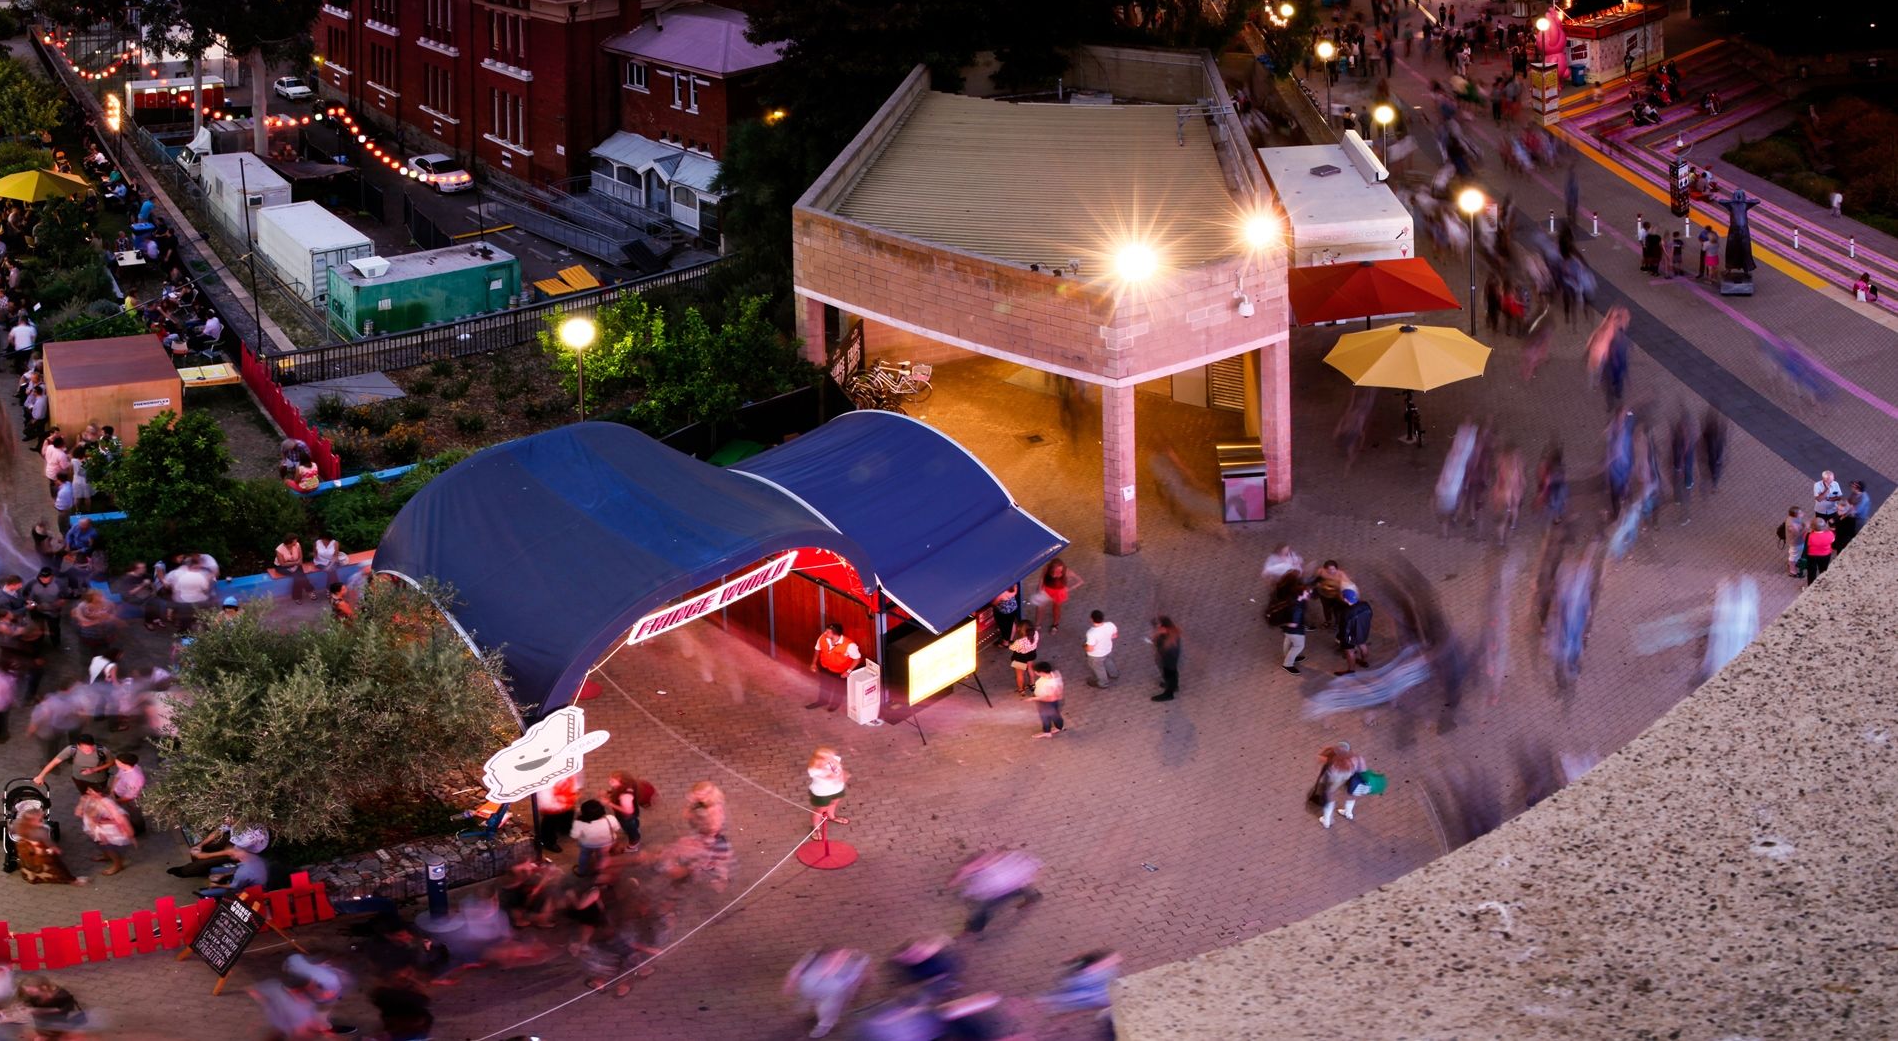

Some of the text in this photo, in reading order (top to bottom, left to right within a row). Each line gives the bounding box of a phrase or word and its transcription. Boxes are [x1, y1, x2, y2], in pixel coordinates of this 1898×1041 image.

[634, 558, 791, 639] FRINGE WORLD
[230, 904, 249, 923] WORLD
[233, 900, 252, 918] FRINGE
